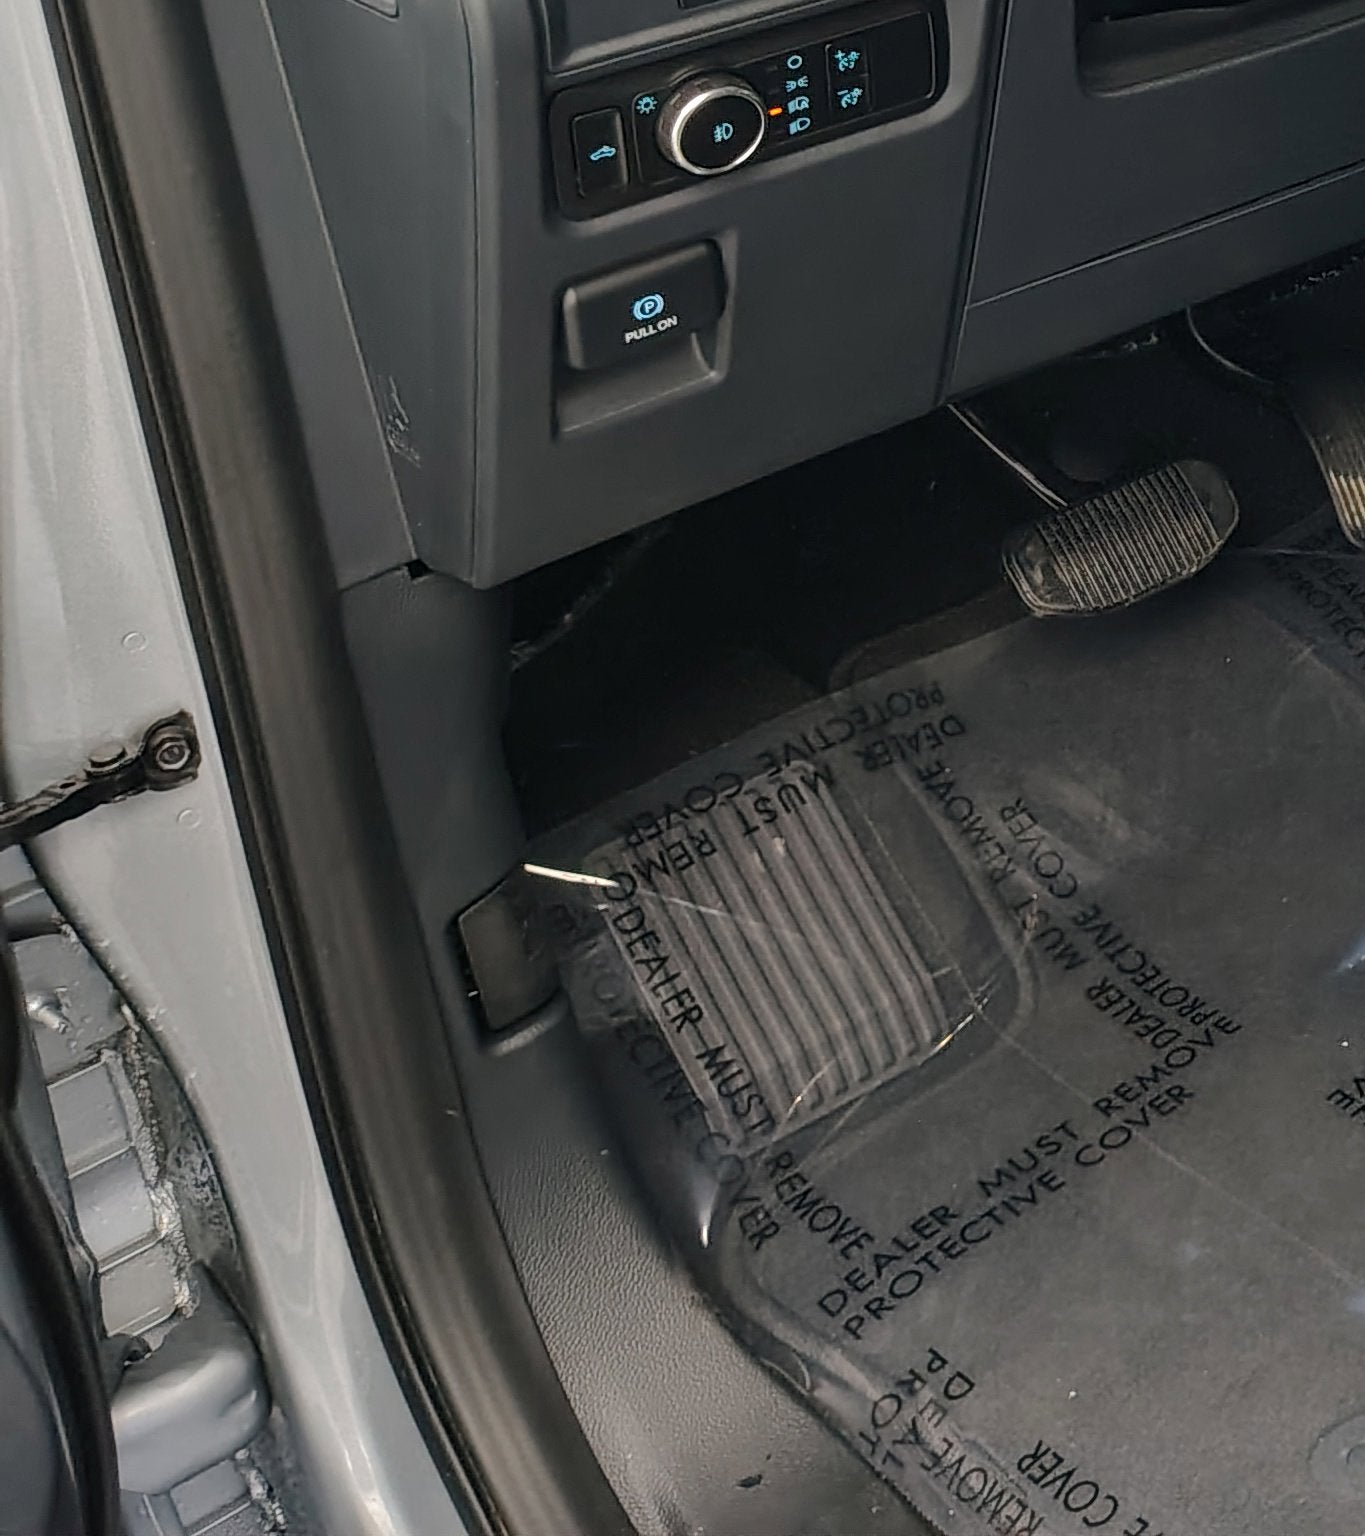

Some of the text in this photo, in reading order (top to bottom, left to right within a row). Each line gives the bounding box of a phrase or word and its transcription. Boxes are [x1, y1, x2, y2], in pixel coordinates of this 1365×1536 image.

[624, 315, 678, 344] PULL ON
[624, 680, 945, 850] PROTECTIVE COVER
[741, 765, 834, 839] MUST
[855, 713, 966, 773] DEALER
[917, 764, 1182, 1050] DEALER MUST REMOVE
[999, 797, 1213, 1028] PROTECTIVE COVER
[613, 906, 874, 1260] DEALER MUST REMOVE
[817, 1010, 1242, 1317] DEALER MUST REMOVE
[843, 1083, 1196, 1341] PROTECTIVE COVER
[1015, 1439, 1120, 1530] COVER
